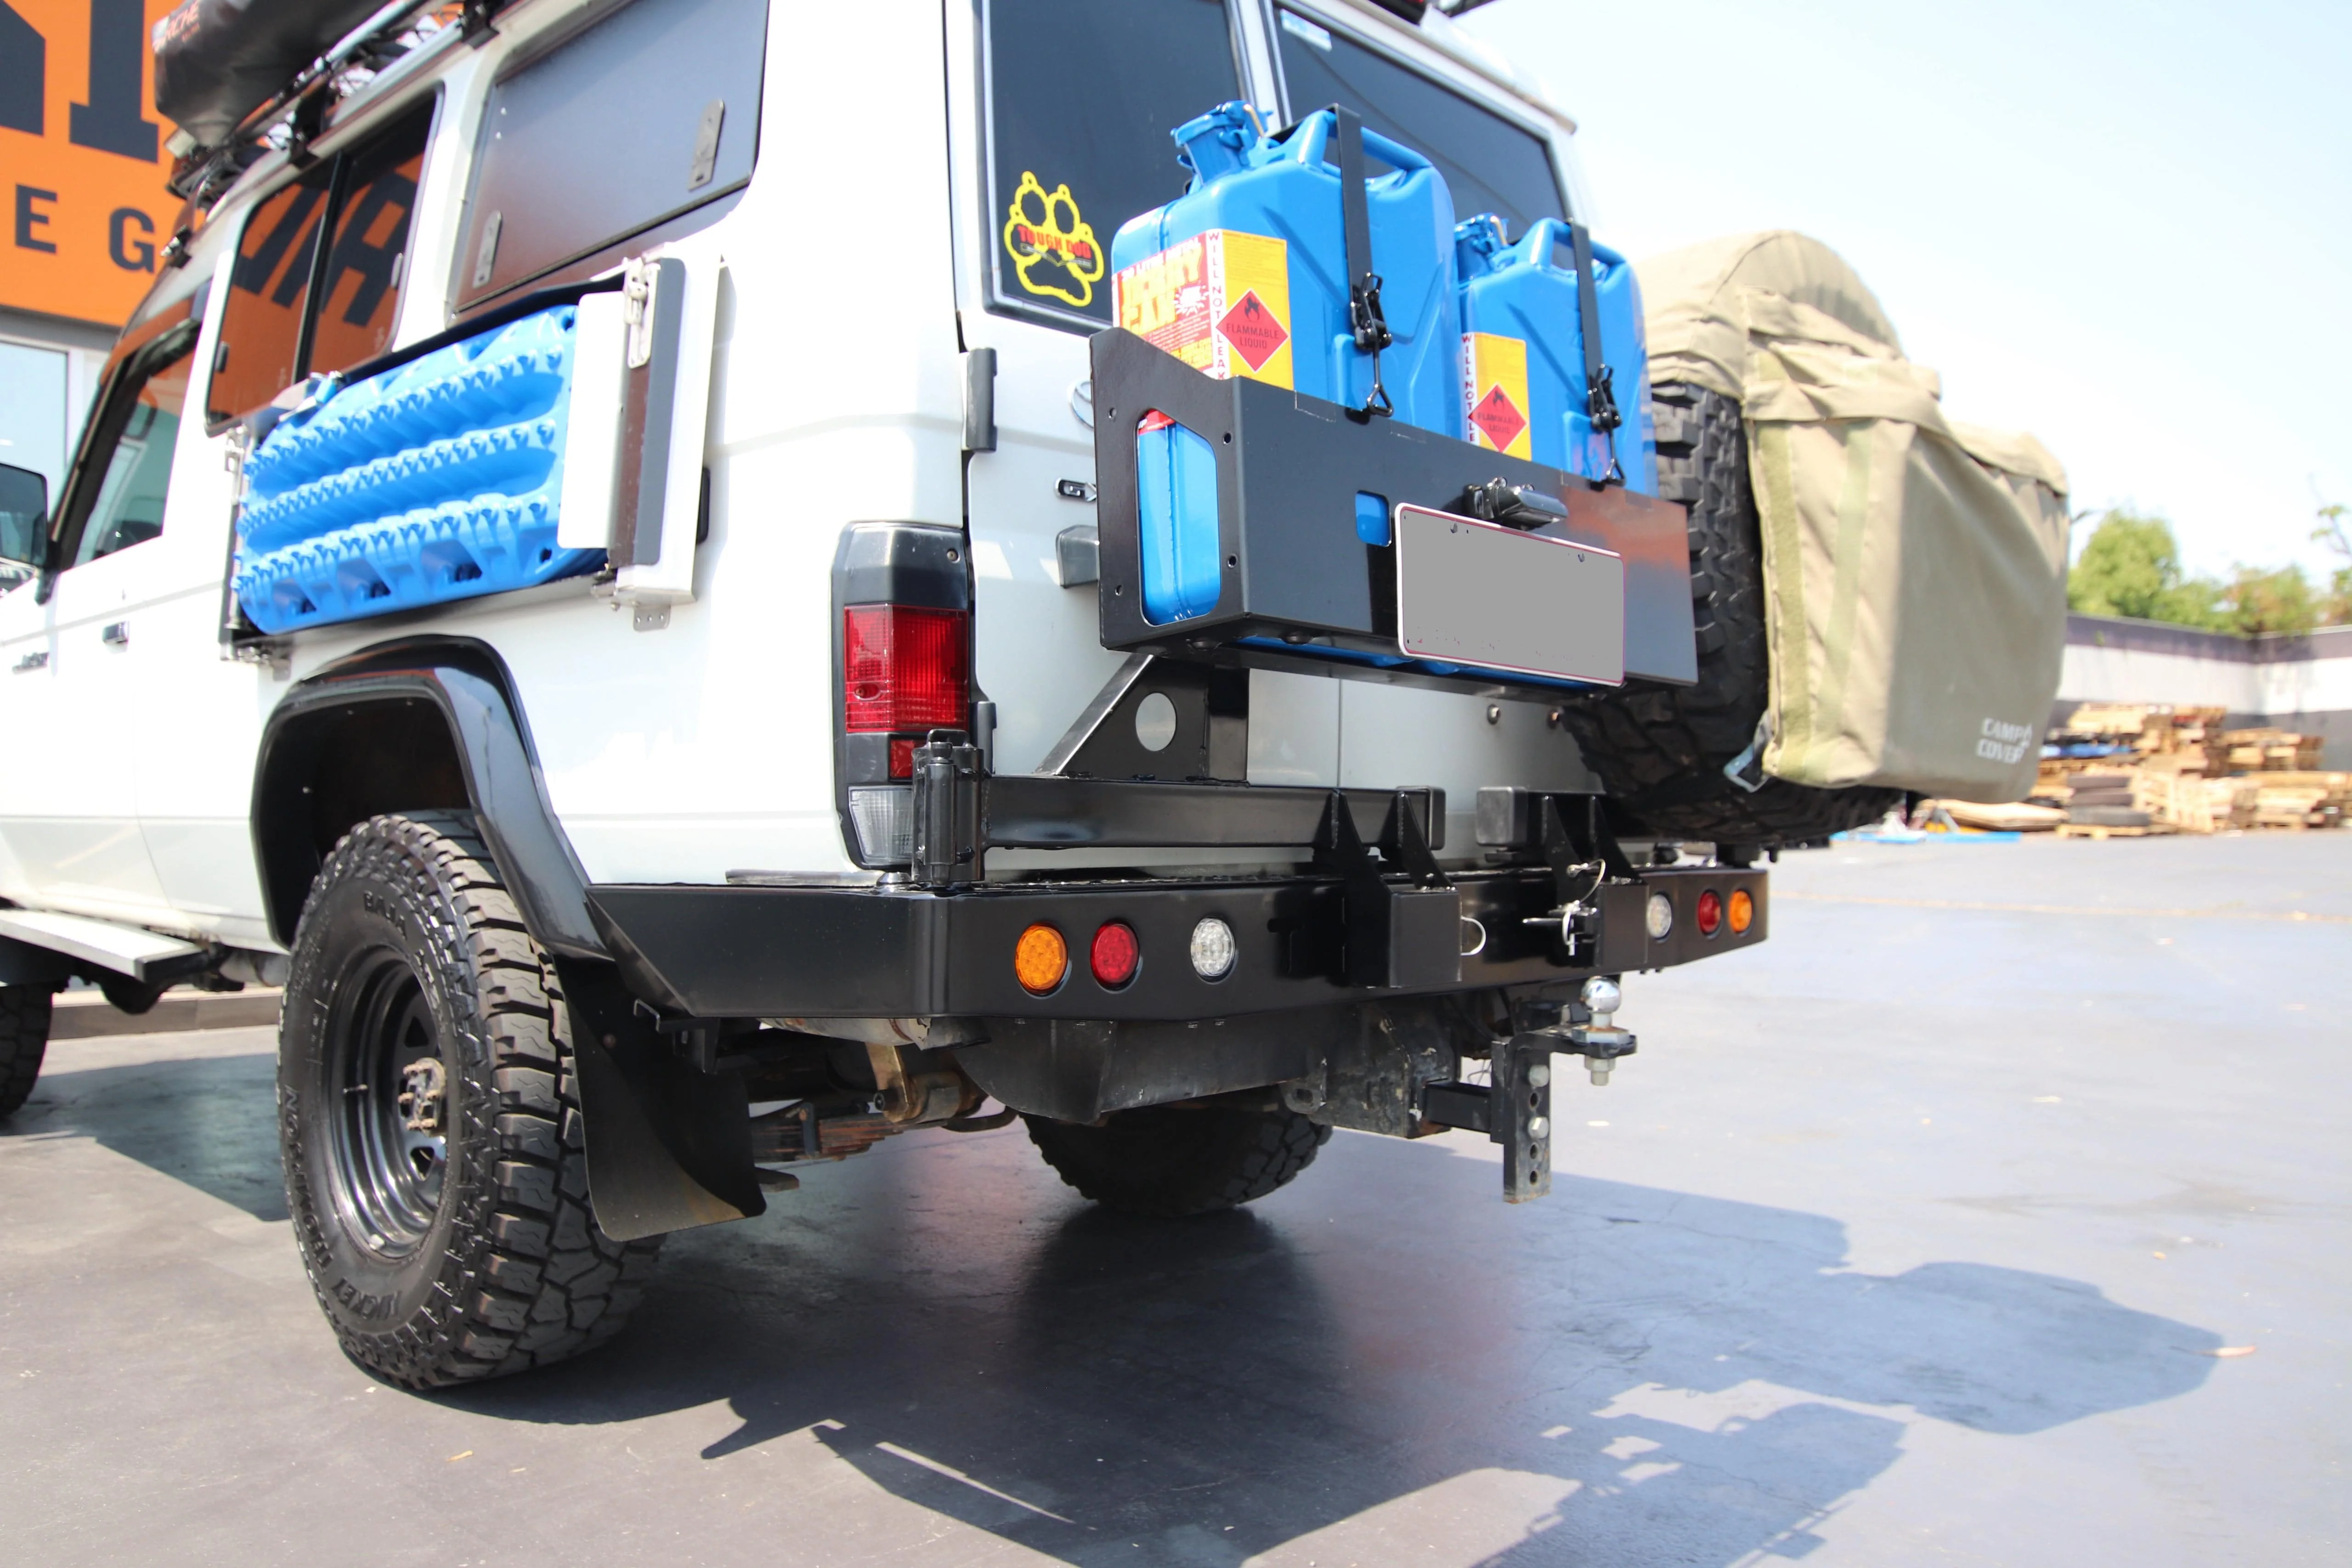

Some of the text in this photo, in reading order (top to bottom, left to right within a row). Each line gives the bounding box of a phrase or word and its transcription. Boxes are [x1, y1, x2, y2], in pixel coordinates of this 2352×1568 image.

[1017, 225, 1062, 250] TOUGH
[1066, 239, 1092, 260] DOG
[1208, 232, 1226, 381] WILL NOT LEAK
[1226, 323, 1279, 339] FLAMMABLE
[1240, 337, 1267, 349] LIQUID
[1462, 335, 1472, 375] WILL
[1465, 382, 1474, 410] NOT
[1976, 738, 2024, 764] COVER
[363, 890, 407, 941] BAJA
[284, 1084, 334, 1274] THOMPSON
